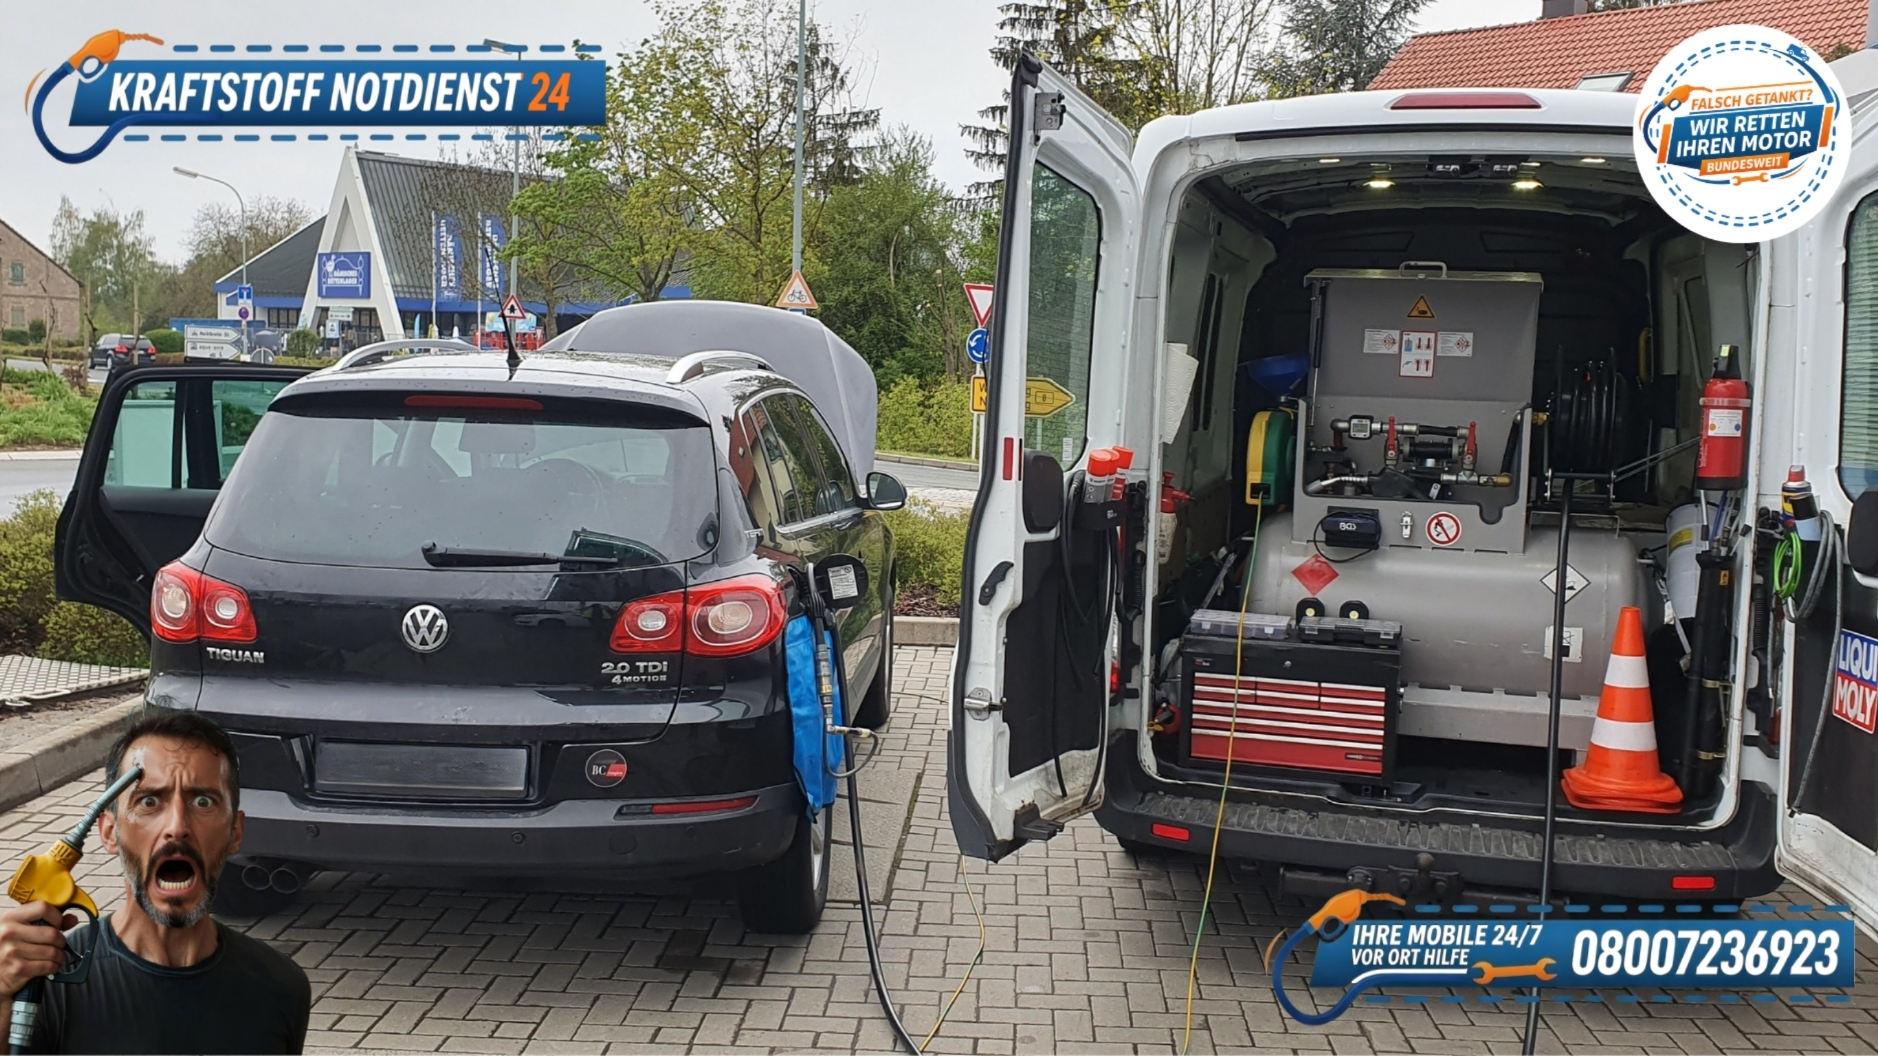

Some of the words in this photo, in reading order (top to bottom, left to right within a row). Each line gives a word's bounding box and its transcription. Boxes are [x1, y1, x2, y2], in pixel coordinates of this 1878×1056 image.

[206, 647, 265, 663] TIGUAN
[1838, 634, 1878, 682] LIQUI
[611, 674, 667, 685] 4MOTION
[1835, 676, 1877, 725] MOLY
[592, 765, 607, 776] BC
